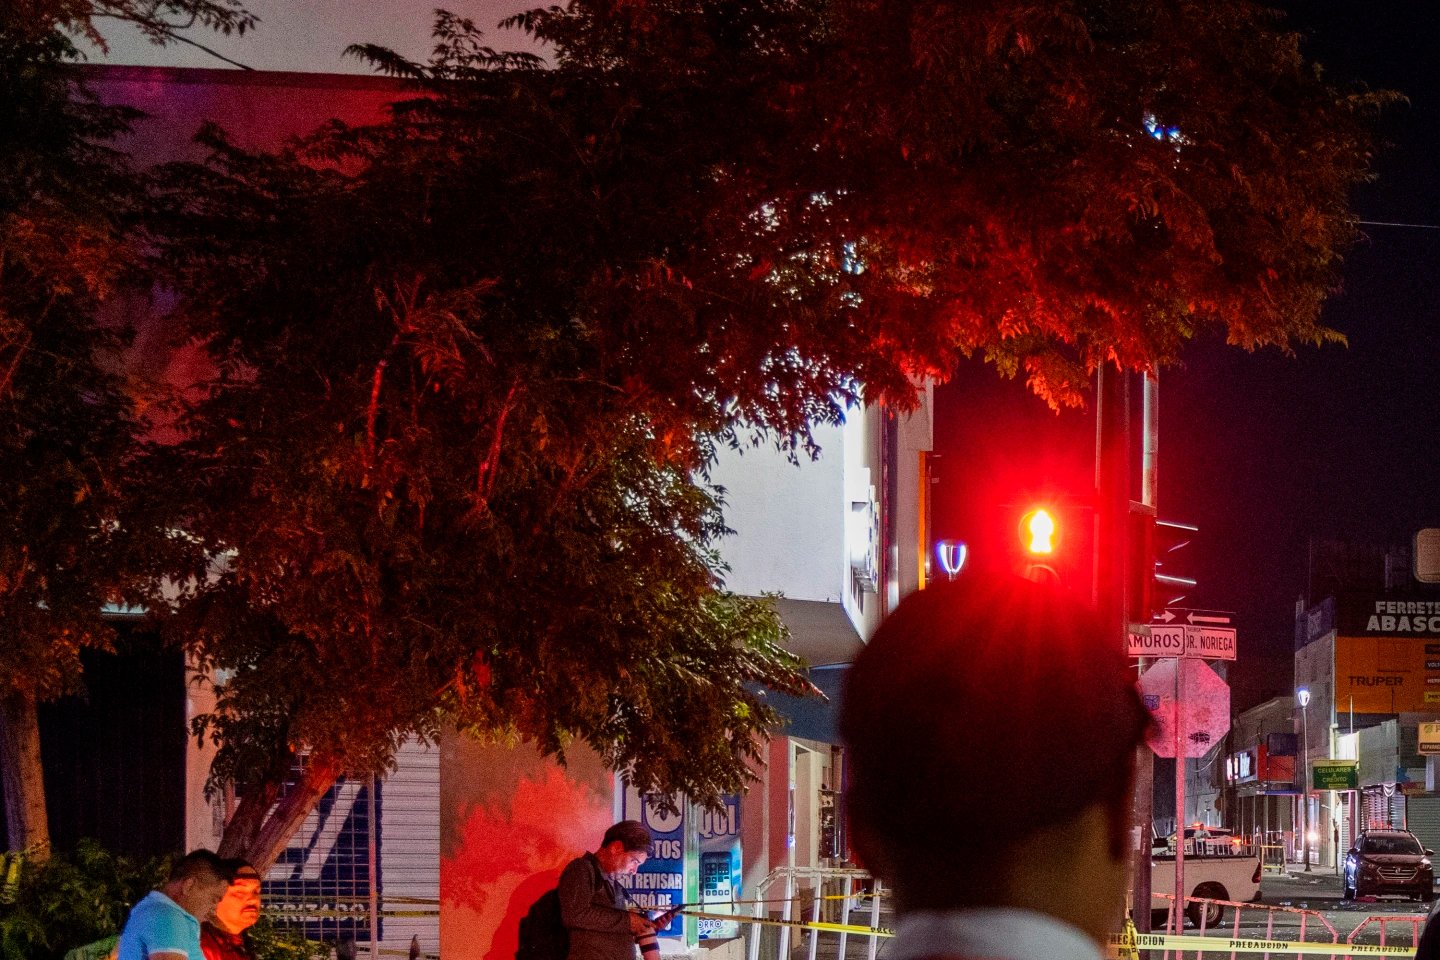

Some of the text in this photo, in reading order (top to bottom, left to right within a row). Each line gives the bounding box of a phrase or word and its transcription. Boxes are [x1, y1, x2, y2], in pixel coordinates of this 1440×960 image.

[1200, 636, 1234, 651] NORIEGA
[1348, 675, 1404, 687] TRUPER
[699, 804, 736, 839] QUI
[648, 840, 681, 859] TOS
[635, 873, 682, 889] REVISAR
[658, 894, 672, 910] DE
[699, 918, 722, 929] ORRO
[1110, 934, 1165, 946] RECUCION
[1229, 940, 1289, 950] PRECAUCION
